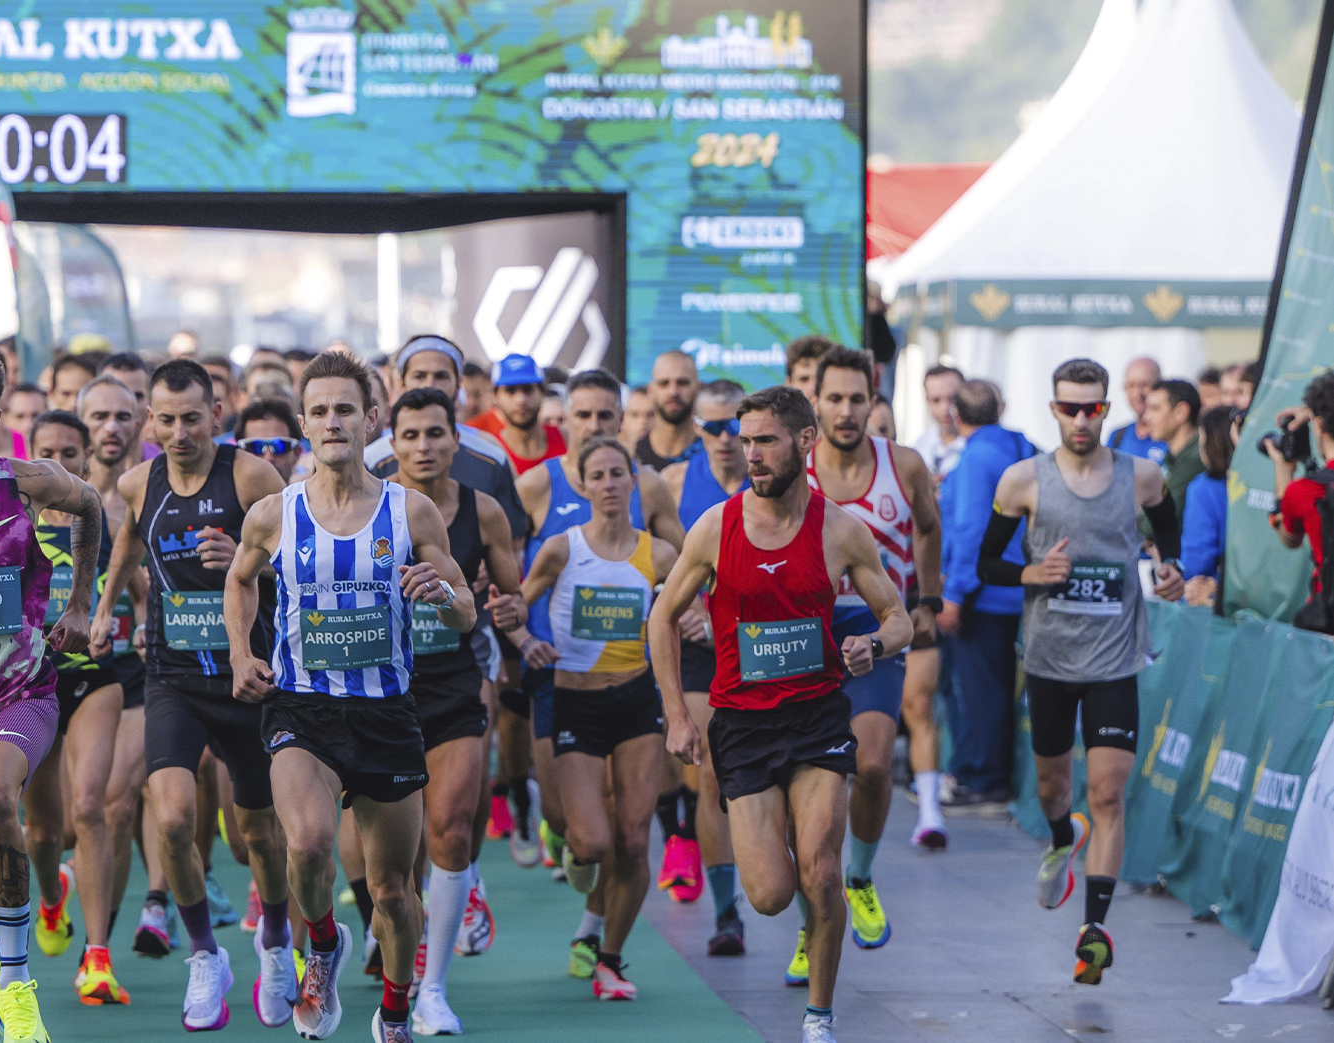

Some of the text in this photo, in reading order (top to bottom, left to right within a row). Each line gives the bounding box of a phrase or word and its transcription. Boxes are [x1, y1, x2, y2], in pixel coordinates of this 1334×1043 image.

[63, 18, 243, 60] KUTXA
[542, 97, 657, 121] DONOSTIA
[672, 97, 719, 121] SAN
[721, 95, 845, 121] SEBASTIÁN
[690, 133, 780, 167] 2024
[331, 581, 392, 593] GIPUZKOA
[1067, 578, 1106, 597] 282
[327, 611, 383, 623] RURAL KUTXA
[581, 605, 633, 619] LLORENS
[602, 618, 614, 630] 12
[764, 622, 816, 636] RURAL KUTXA
[200, 626, 209, 638] 4
[304, 628, 386, 645] ARROSPIDE
[421, 631, 434, 644] 12
[342, 645, 349, 657] 1
[753, 639, 808, 657] URRUTY
[778, 655, 786, 667] 3
